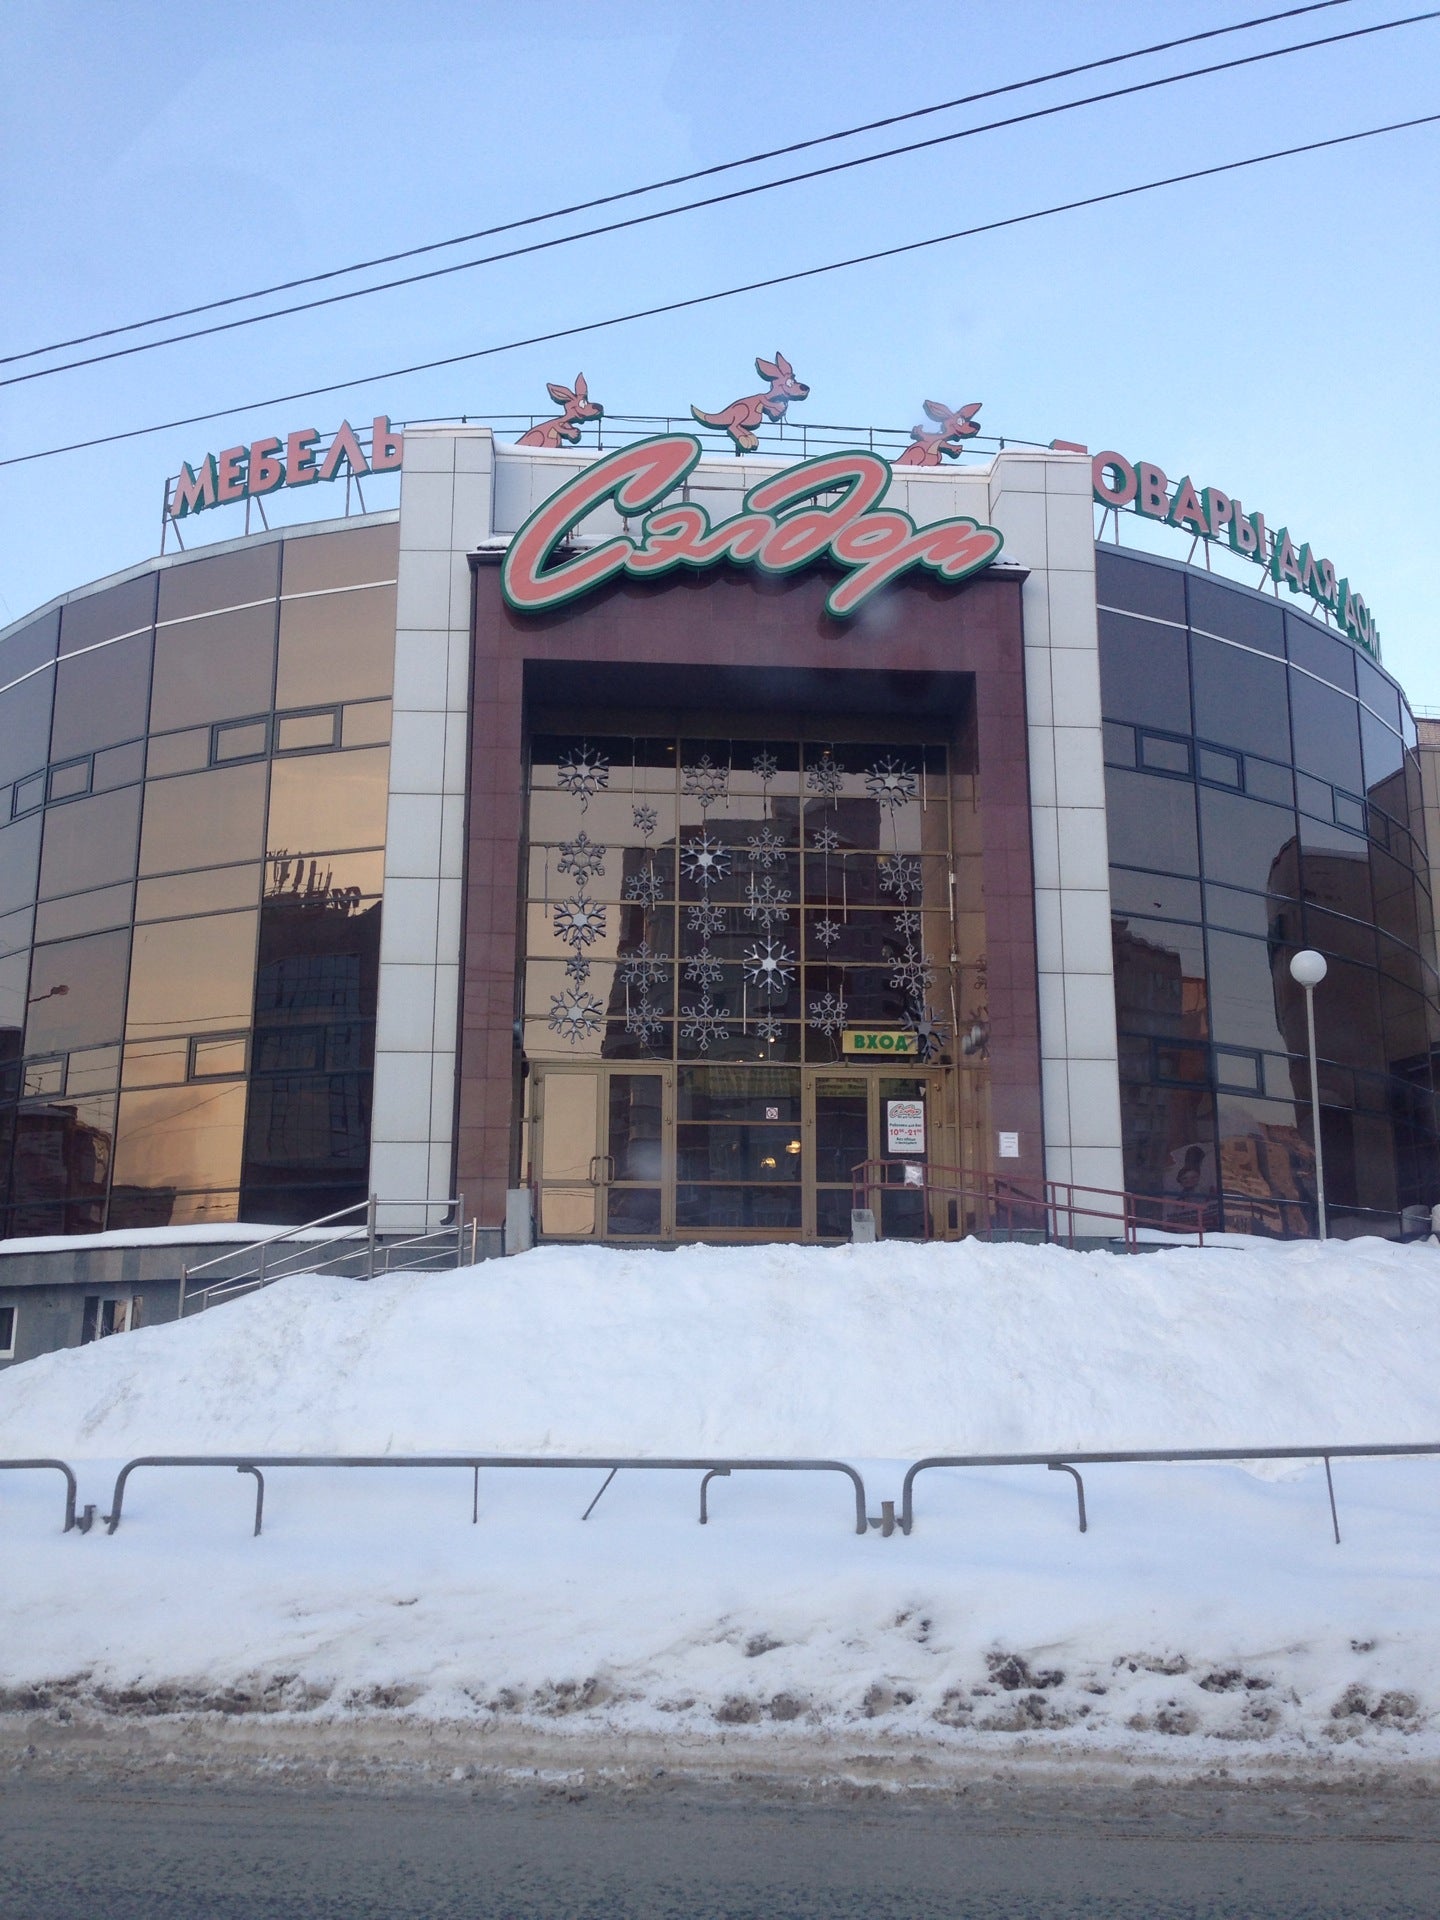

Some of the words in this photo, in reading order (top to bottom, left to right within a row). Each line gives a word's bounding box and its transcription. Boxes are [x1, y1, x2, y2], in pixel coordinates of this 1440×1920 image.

[170, 414, 403, 518] МЕБЕЛЬ
[1049, 438, 1268, 564] ОВАРЫ
[1271, 526, 1338, 610] ДЛЯ
[853, 1034, 909, 1051] ВХОД
